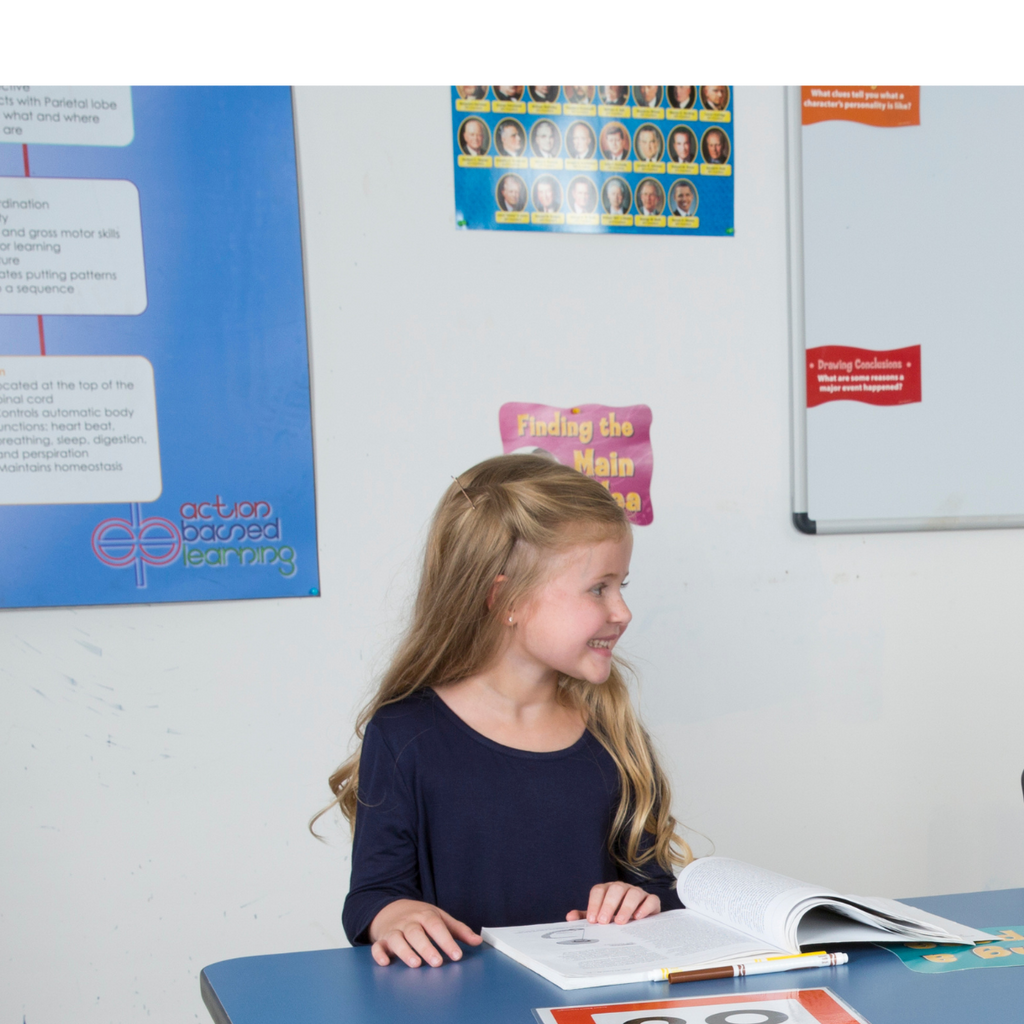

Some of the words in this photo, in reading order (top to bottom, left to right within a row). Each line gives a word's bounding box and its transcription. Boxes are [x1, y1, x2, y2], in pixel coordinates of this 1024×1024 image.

[811, 89, 831, 98] What
[832, 90, 850, 98] clues
[852, 90, 863, 98] tell
[865, 92, 879, 100] you
[880, 91, 898, 100] what
[17, 96, 41, 107] with
[44, 97, 88, 109] Parietal
[91, 99, 118, 110] lobe
[804, 99, 843, 109] character's
[844, 101, 886, 111] personality
[887, 102, 894, 110] is
[894, 102, 912, 110] like?
[3, 110, 33, 121] what
[37, 112, 60, 122] and
[63, 114, 100, 124] where
[3, 126, 22, 135] are
[0, 199, 49, 210] dination
[2, 228, 25, 238] and
[29, 229, 57, 240] gross
[61, 228, 94, 239] motor
[98, 228, 120, 239] skills
[14, 242, 61, 254] learning
[26, 269, 67, 282] putting
[70, 270, 117, 281] patterns
[5, 284, 13, 293] a
[17, 284, 75, 295] sequence
[818, 359, 853, 373] Drawing
[855, 357, 902, 370] Conclusions
[817, 374, 837, 382] What
[871, 374, 898, 382] reasons
[41, 381, 53, 391] at
[57, 380, 75, 391] the
[79, 380, 98, 392] top
[101, 380, 113, 390] of
[115, 380, 134, 390] the
[819, 384, 841, 394] major
[863, 383, 903, 393] happened?
[26, 394, 54, 404] cord
[0, 408, 39, 419] ontrols
[42, 407, 101, 418] automatic
[104, 407, 134, 419] body
[51, 422, 81, 431] heart
[517, 411, 593, 444] Finding
[599, 412, 634, 437] the
[0, 435, 53, 448] reathing,
[22, 448, 89, 461] perspiration
[55, 461, 123, 473] homeostasis
[573, 448, 635, 477] Main
[180, 494, 272, 520] action
[183, 543, 296, 577] learning
[922, 953, 958, 963] a
